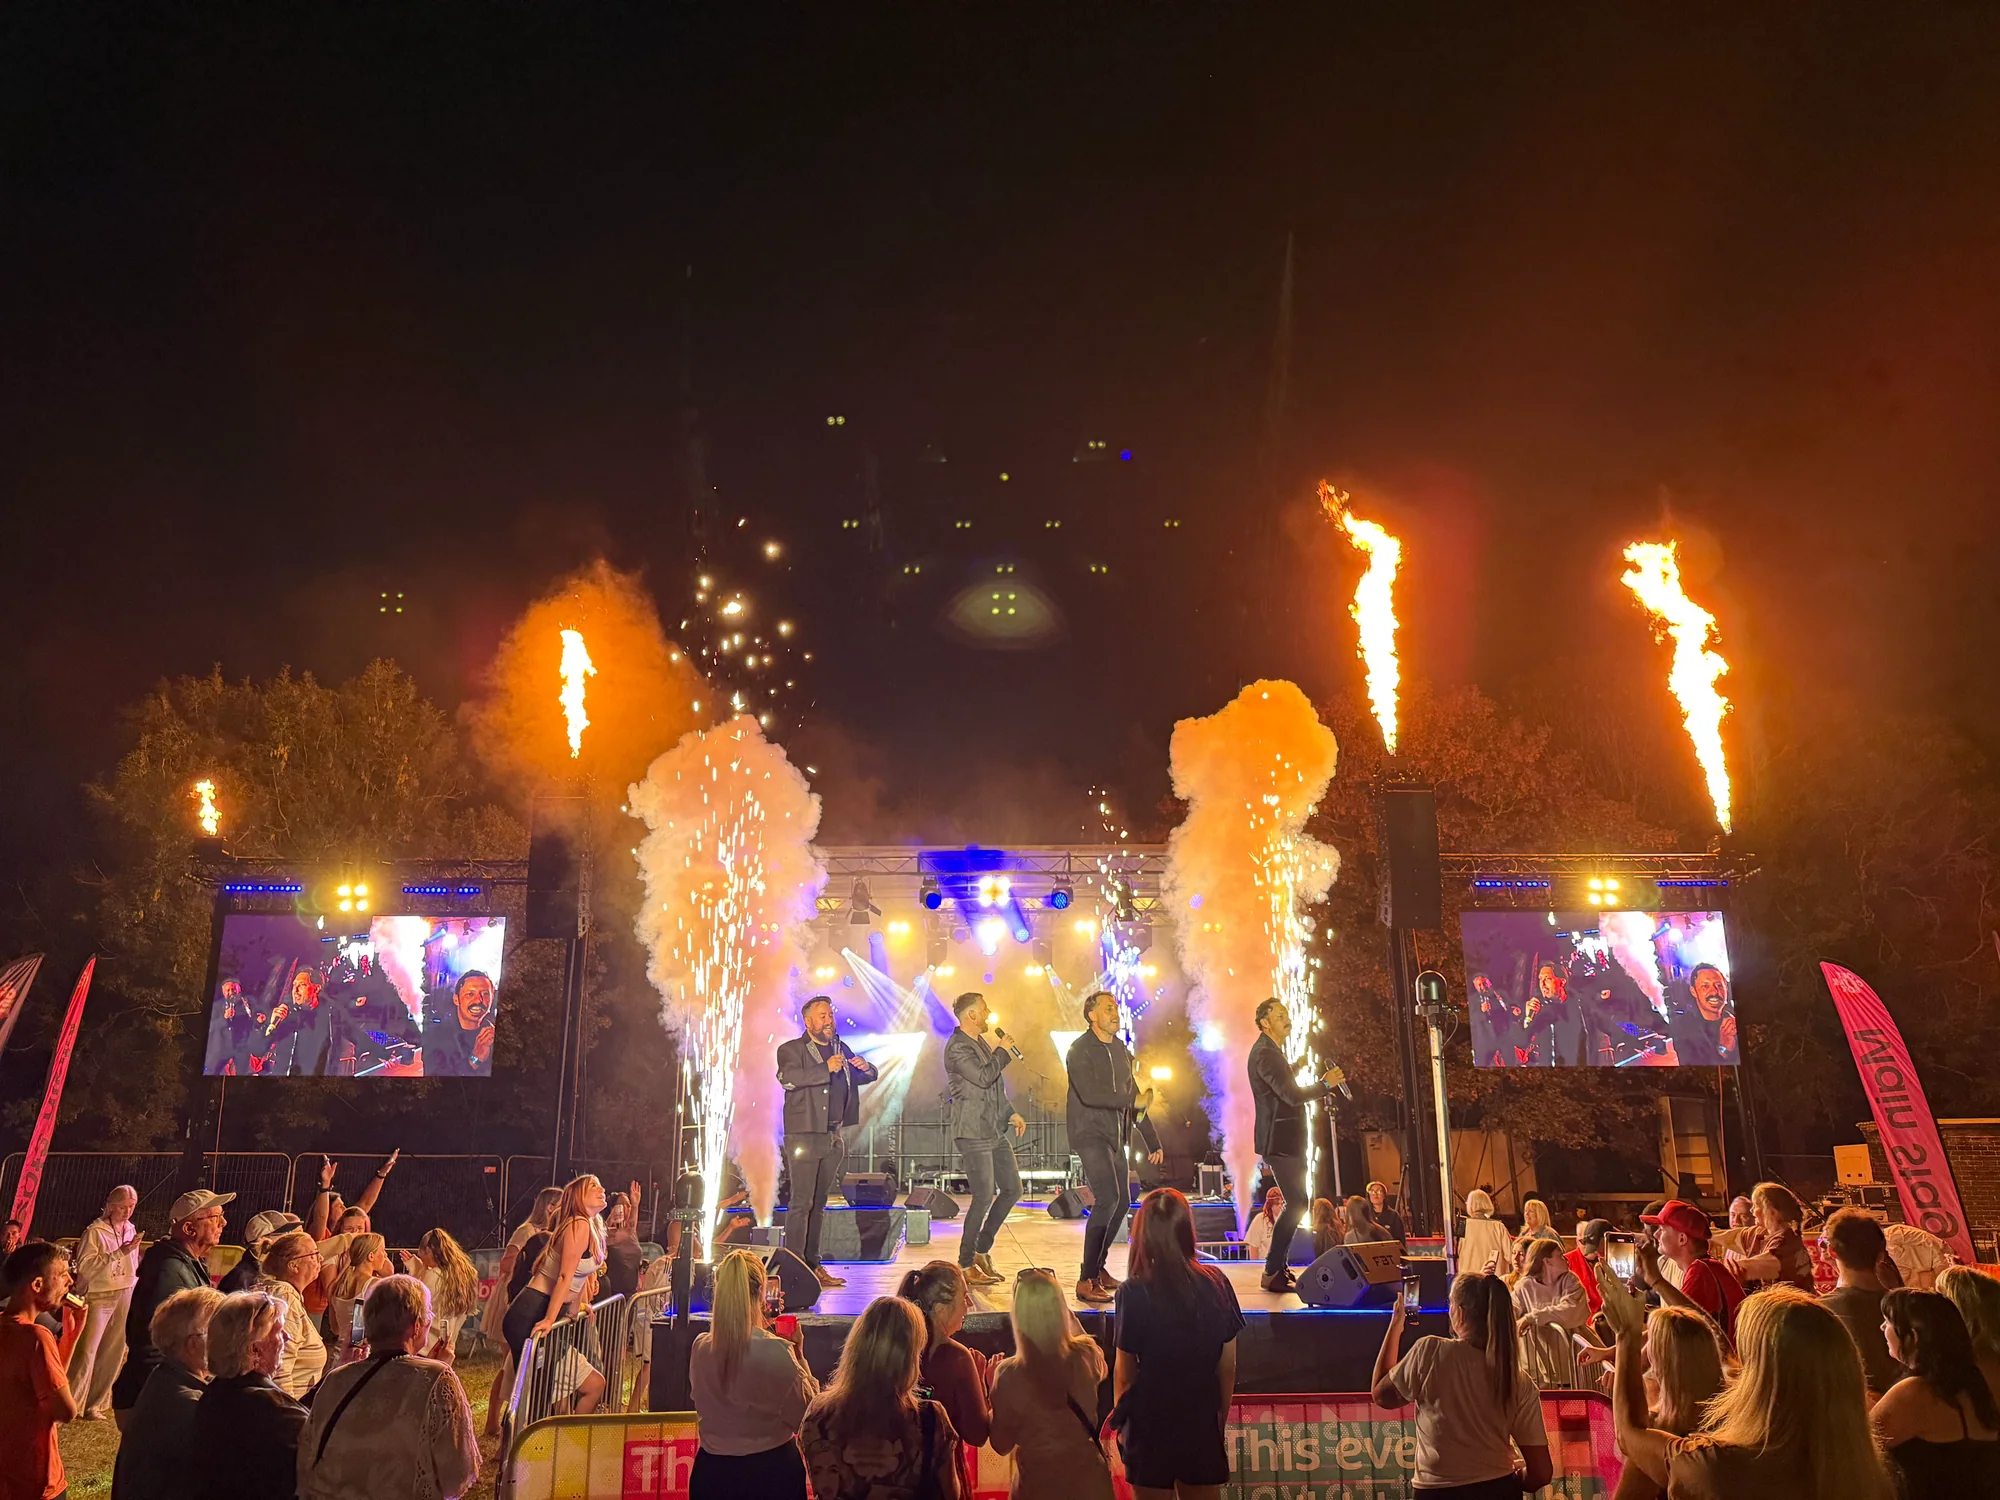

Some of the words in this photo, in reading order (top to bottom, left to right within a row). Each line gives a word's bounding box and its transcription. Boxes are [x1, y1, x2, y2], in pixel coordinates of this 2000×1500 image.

[1372, 1255, 1395, 1266] FBT
[631, 1446, 694, 1492] Th
[1227, 1429, 1320, 1472] This
[1336, 1437, 1416, 1471] eve
